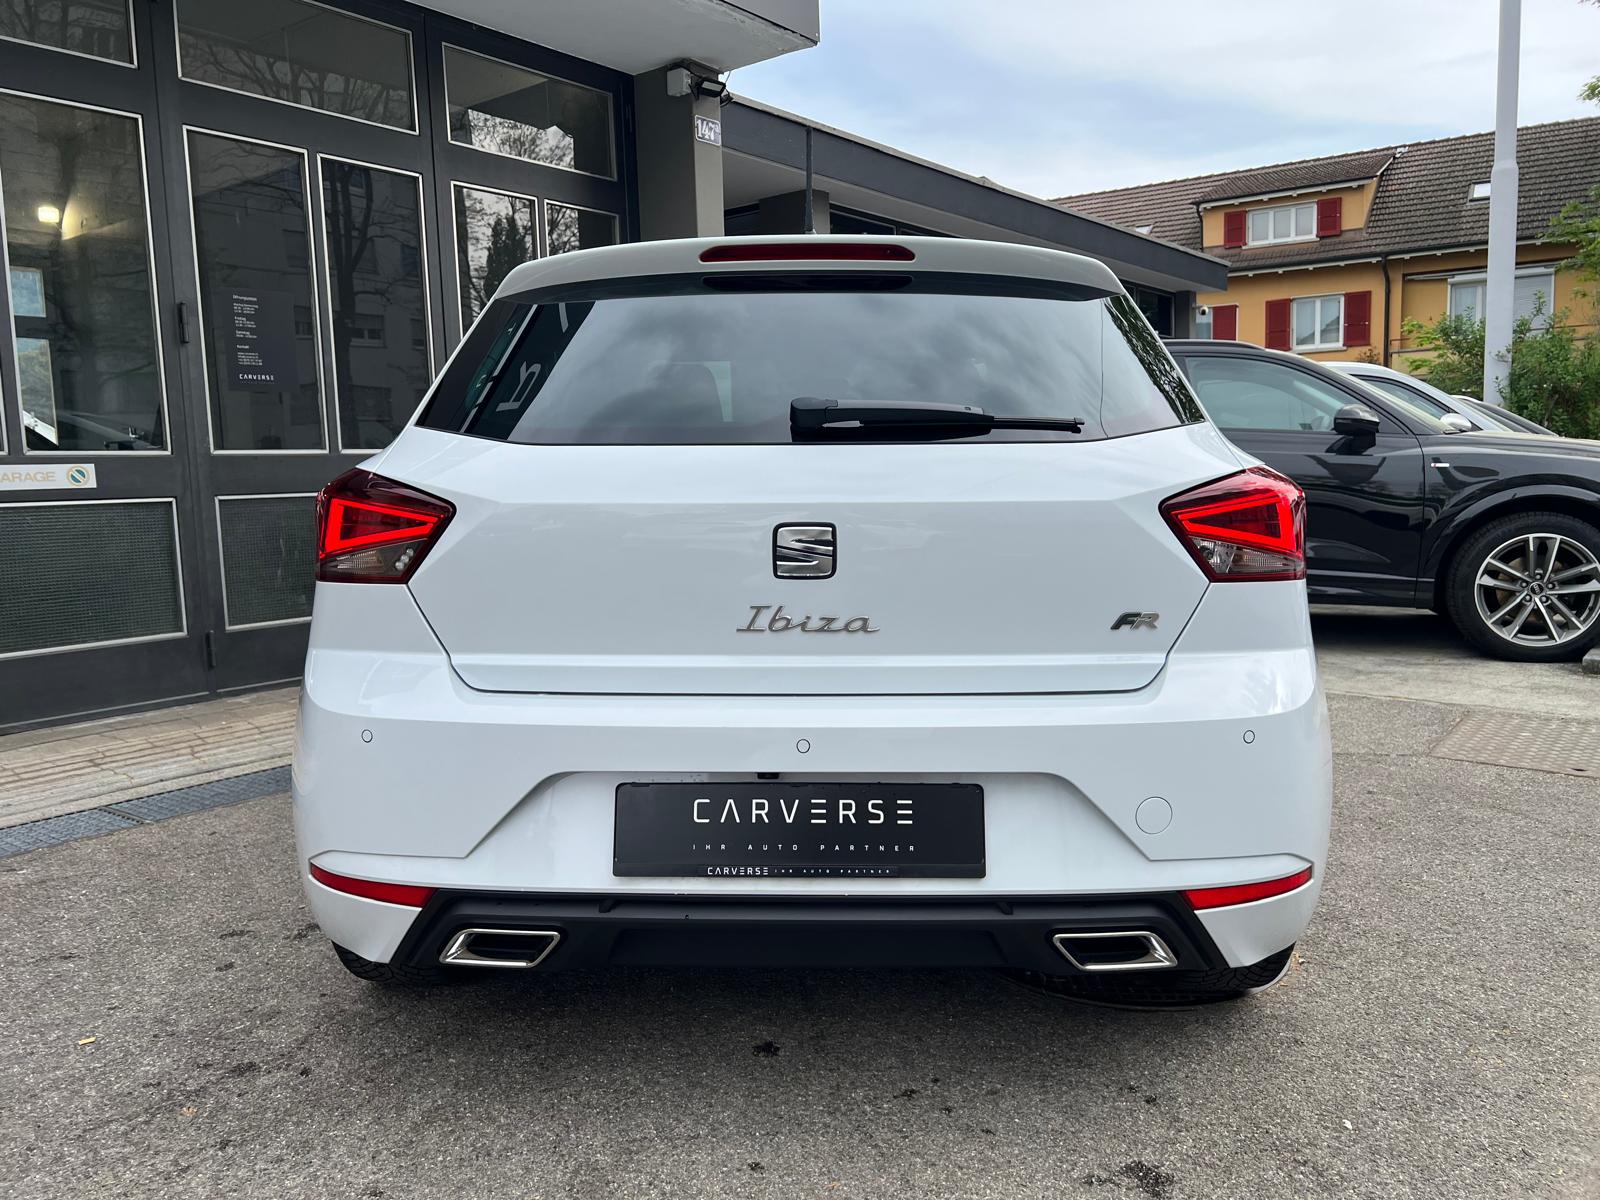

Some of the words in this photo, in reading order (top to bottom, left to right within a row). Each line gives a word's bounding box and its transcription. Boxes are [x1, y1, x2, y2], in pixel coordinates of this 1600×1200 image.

[0, 471, 56, 483] ARAGE
[736, 605, 880, 633] Ibiza
[1110, 611, 1160, 630] FR
[693, 798, 913, 825] CARVERSE
[820, 844, 915, 852] PARTNER
[707, 866, 769, 876] CARVERSE
